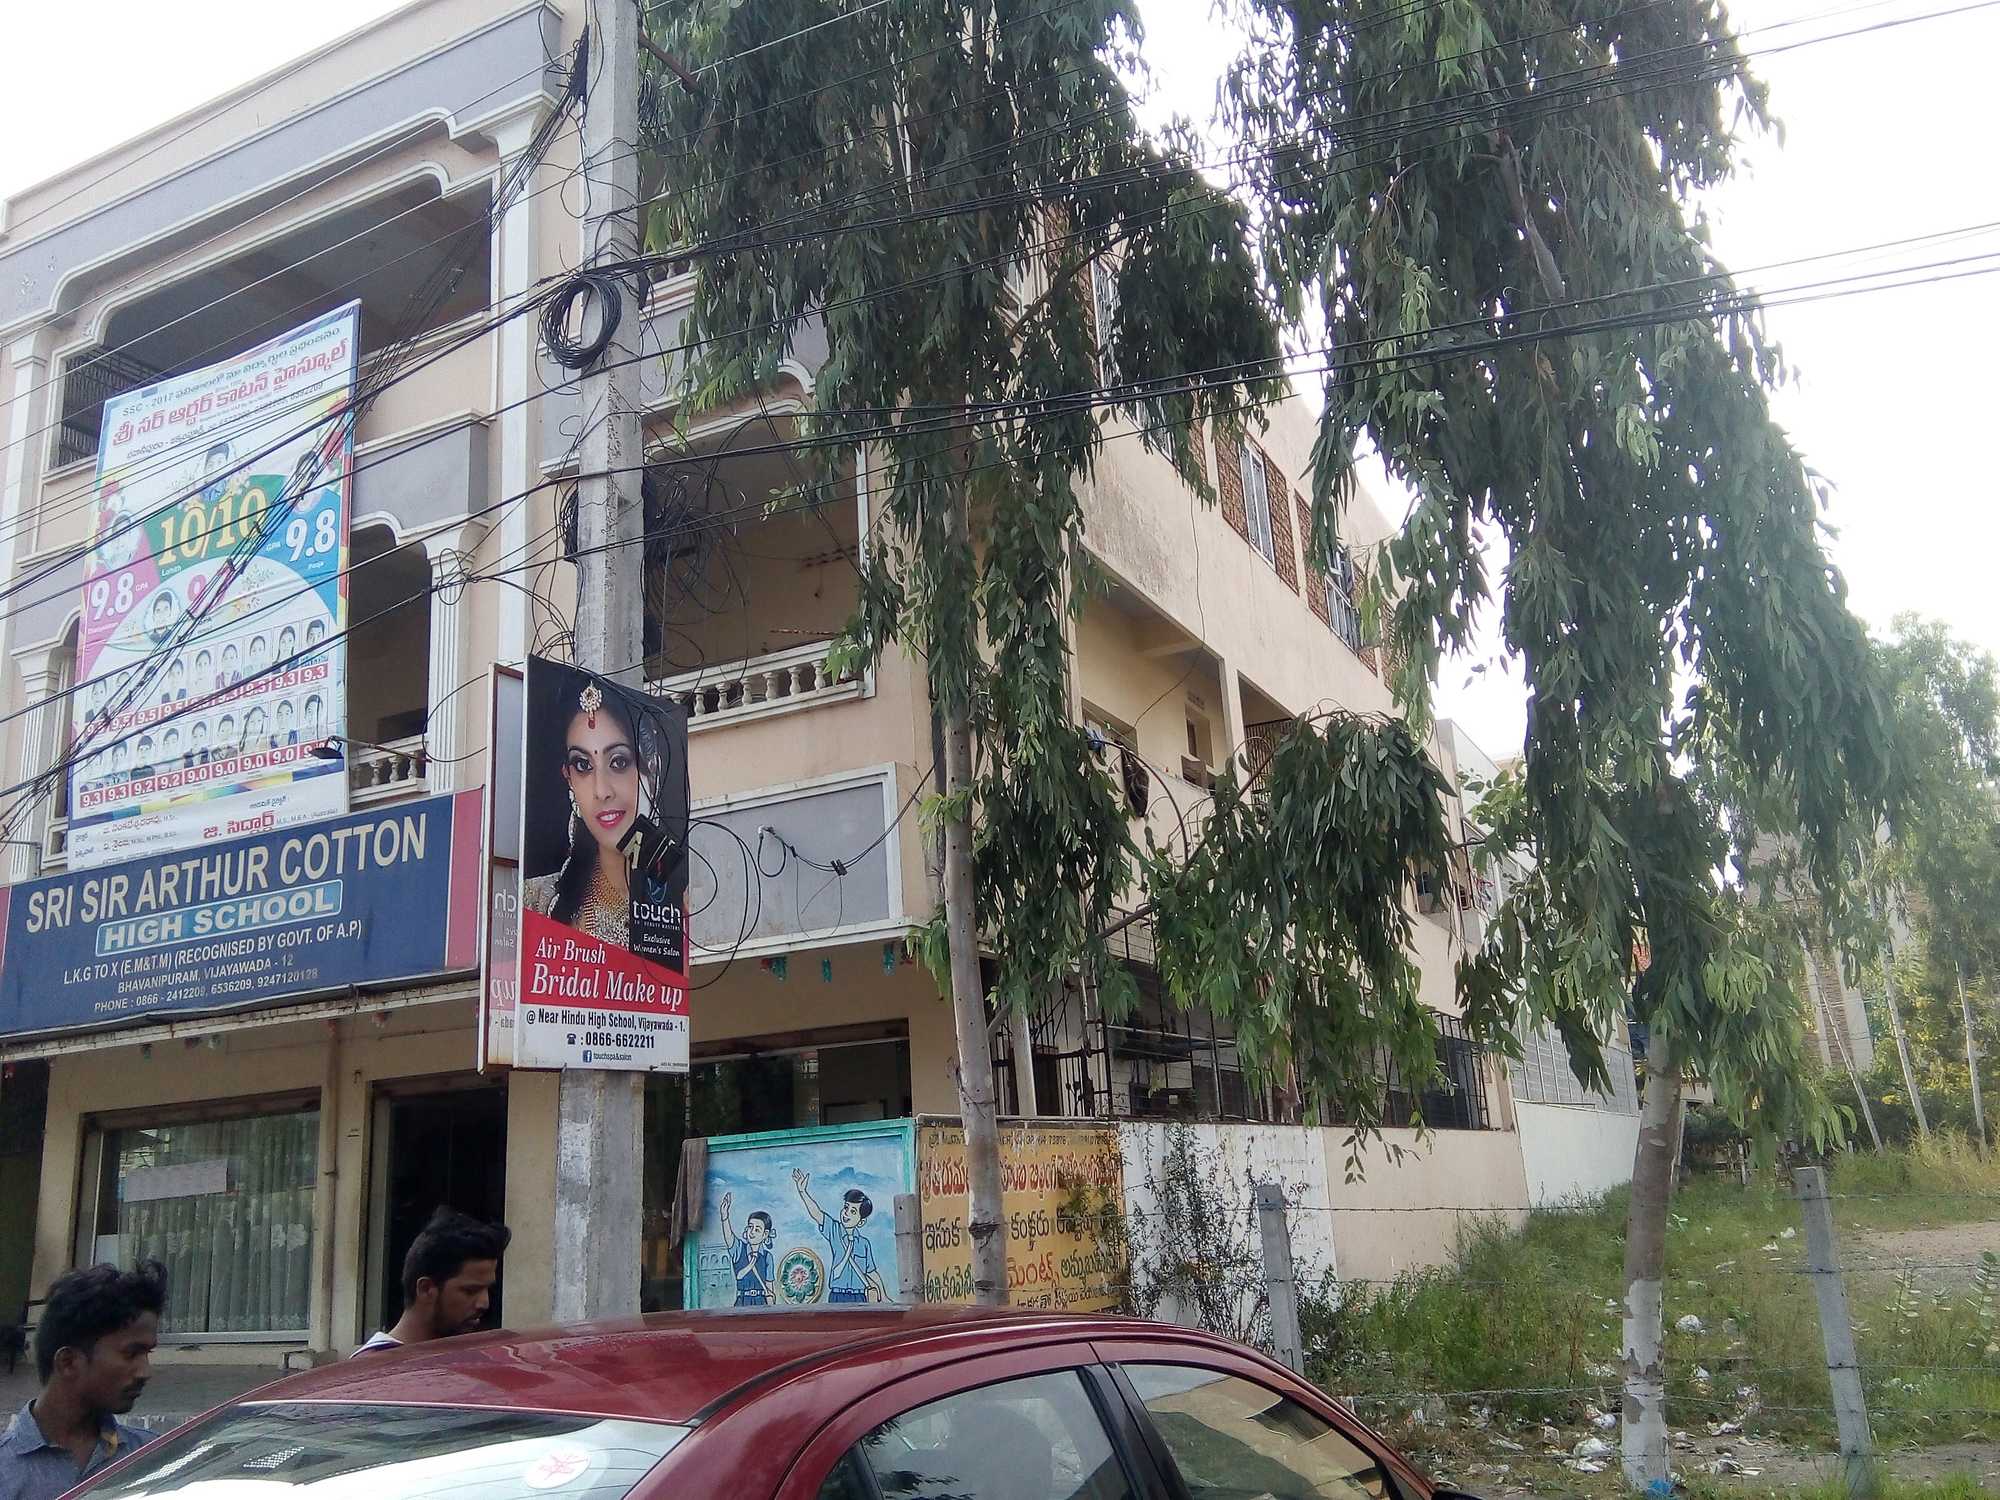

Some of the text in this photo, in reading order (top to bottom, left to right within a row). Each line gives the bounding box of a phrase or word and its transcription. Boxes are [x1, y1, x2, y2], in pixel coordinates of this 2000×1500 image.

[215, 374, 269, 408] కాటన్
[272, 339, 349, 391] హైస్కూల్
[157, 486, 270, 566] 10/10
[285, 509, 337, 563] 9.8
[90, 572, 135, 621] 9.8
[138, 710, 156, 724] 9.5
[276, 673, 296, 687] 9.3
[304, 666, 325, 680] 9.3
[83, 793, 101, 807] 9.3
[109, 787, 127, 801] 9.3
[135, 779, 153, 793] 9.2
[161, 775, 179, 788] 9.2
[187, 768, 207, 782] 9.0
[215, 763, 235, 777] 9.0
[244, 756, 264, 769] 9.0
[272, 748, 294, 762] 9.0
[27, 886, 74, 933] SRI
[81, 874, 130, 924] SIR
[134, 845, 269, 914] ARTHUR
[279, 812, 427, 887] COTTON
[104, 887, 336, 952] HIGH SCHOOL
[633, 902, 682, 924] touch
[64, 966, 92, 986] L.K.G
[95, 963, 109, 979] TO
[110, 963, 118, 976] X
[174, 939, 254, 970] (RECOGNISED
[258, 935, 275, 952] BY
[277, 928, 313, 947] GOVT.
[317, 925, 333, 943] OF
[535, 936, 607, 965] Air Brush
[643, 933, 671, 945] Exclusive
[663, 947, 680, 957] Salon
[118, 969, 201, 994] BHAVANIPURAM,
[205, 958, 272, 980] VIJAYAWADA
[530, 962, 683, 1012] Bridal Make up
[94, 1000, 128, 1012] PHONE
[136, 993, 158, 1007] 0866
[538, 1008, 559, 1025] Near
[561, 1009, 586, 1025] Hindu
[588, 1011, 607, 1029] High
[608, 1012, 637, 1030] School,
[638, 1016, 674, 1033] Vijayawada
[925, 1216, 961, 1253] ఇసుక
